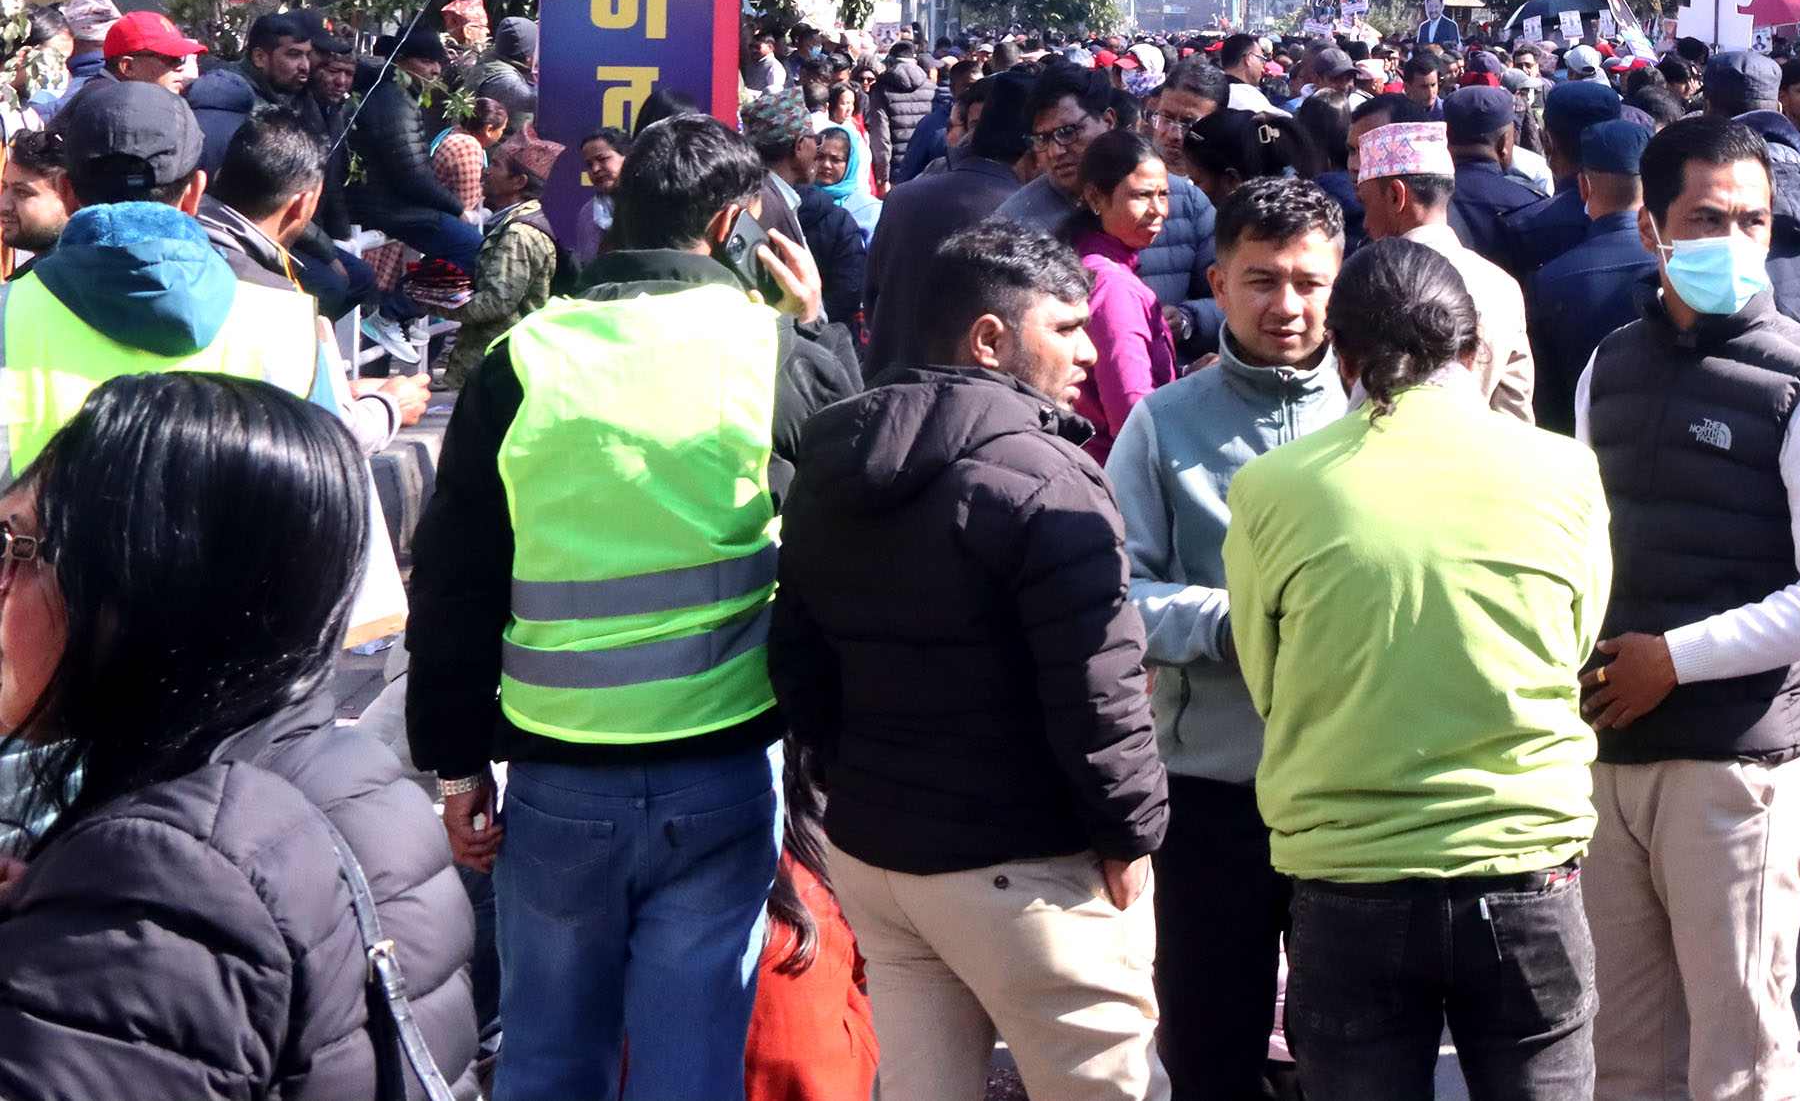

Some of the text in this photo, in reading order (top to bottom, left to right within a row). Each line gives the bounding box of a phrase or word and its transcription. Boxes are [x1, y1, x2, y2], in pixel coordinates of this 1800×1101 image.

[1703, 418, 1721, 428] THE
[1688, 423, 1719, 439] NORTH
[1696, 433, 1718, 446] FACE
